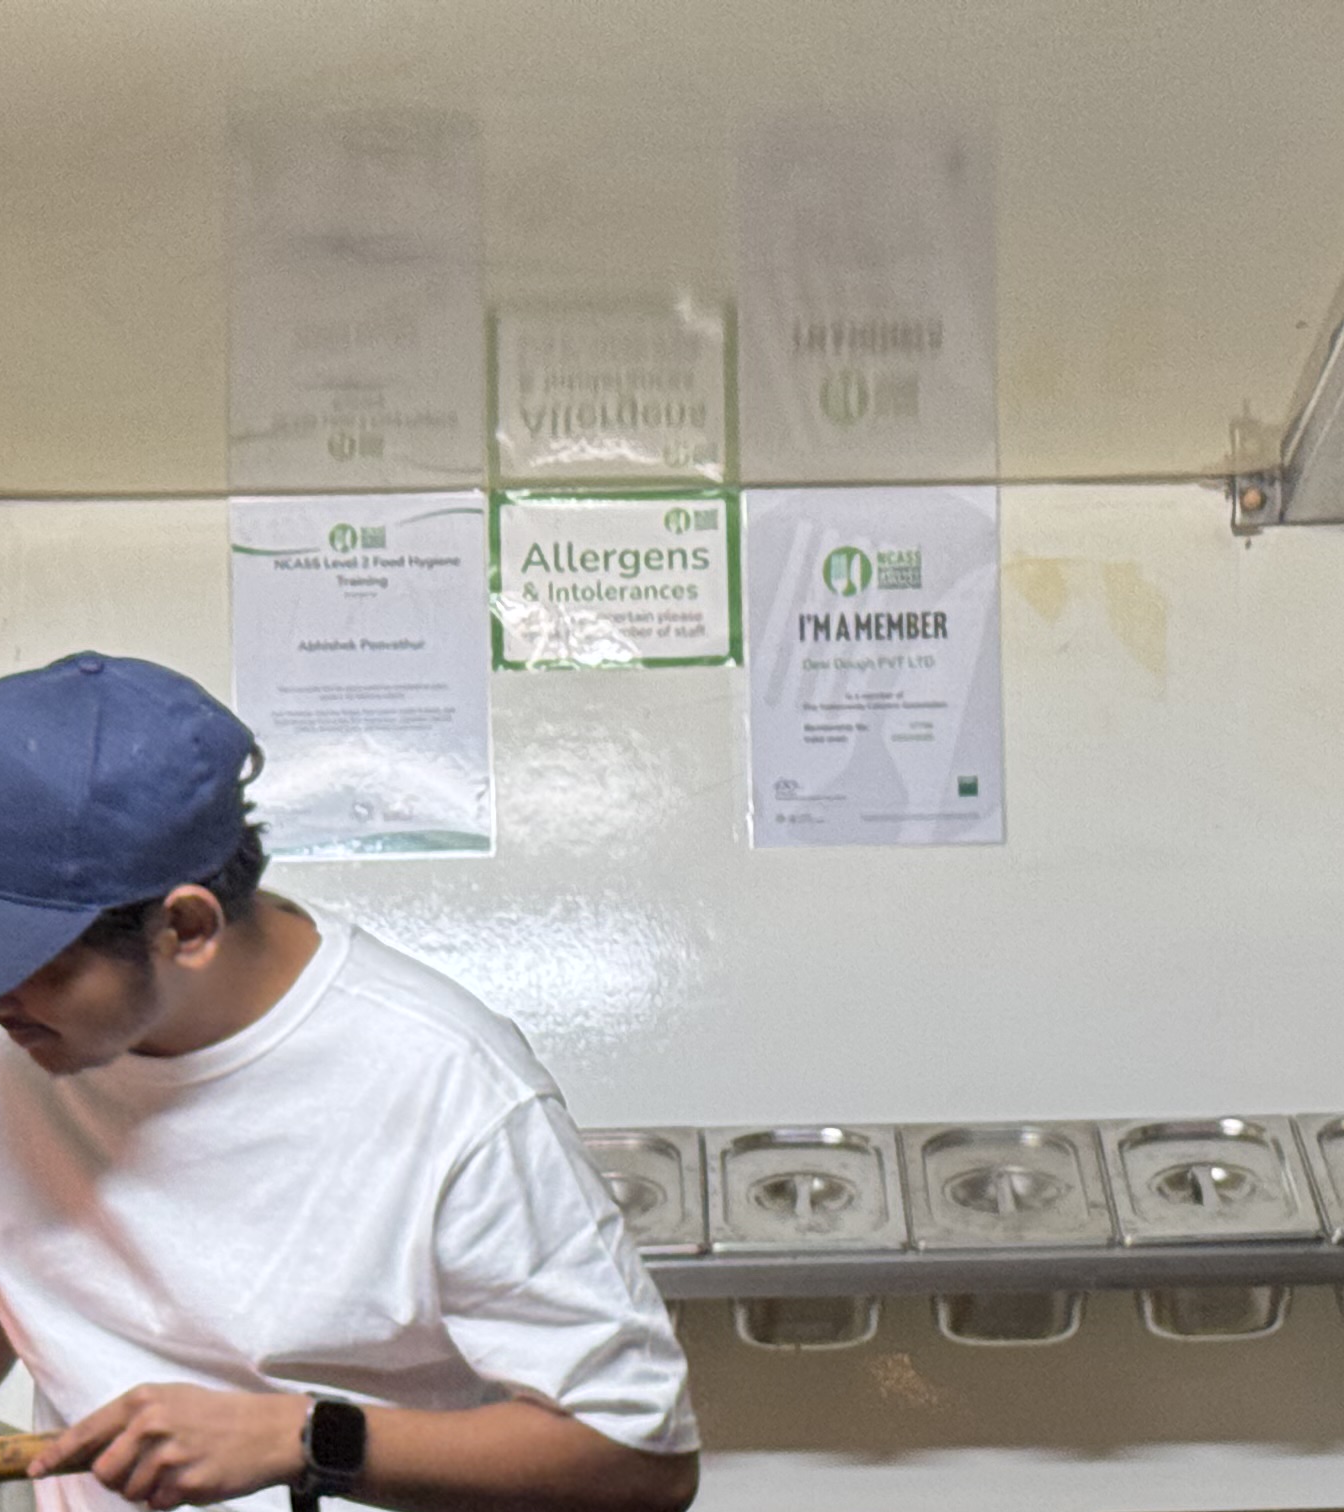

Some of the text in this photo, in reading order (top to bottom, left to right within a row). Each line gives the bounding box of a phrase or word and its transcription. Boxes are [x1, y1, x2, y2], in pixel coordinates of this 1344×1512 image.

[323, 556, 359, 569] Level
[372, 555, 405, 568] Food
[408, 555, 461, 569] Hygiene
[520, 540, 711, 579] Allergens
[336, 574, 389, 588] Training
[522, 579, 699, 602] & Intolerances
[798, 611, 949, 642] I'M A MEMBER
